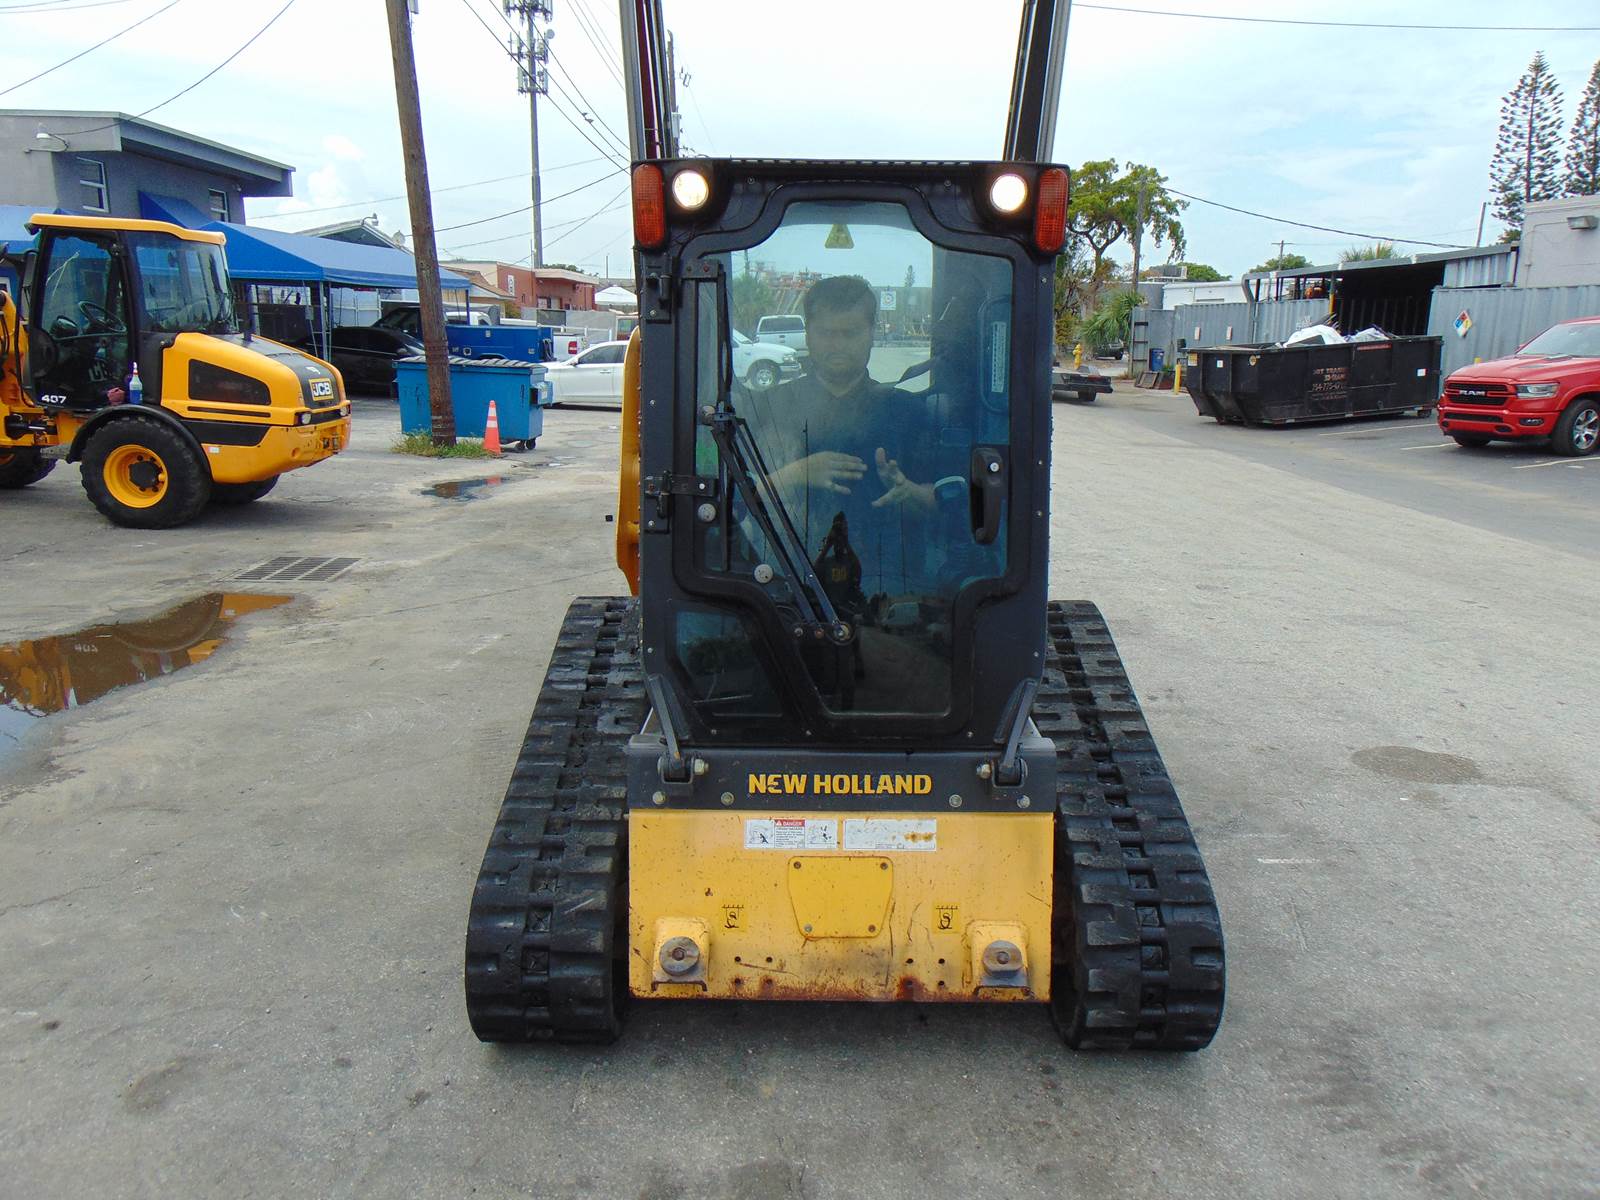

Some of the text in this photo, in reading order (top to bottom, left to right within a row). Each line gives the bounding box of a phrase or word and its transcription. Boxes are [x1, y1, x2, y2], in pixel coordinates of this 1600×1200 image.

[312, 381, 332, 397] JCB
[1459, 389, 1486, 397] RAM
[41, 394, 66, 404] 407
[749, 774, 932, 795] NEW HOLLAND
